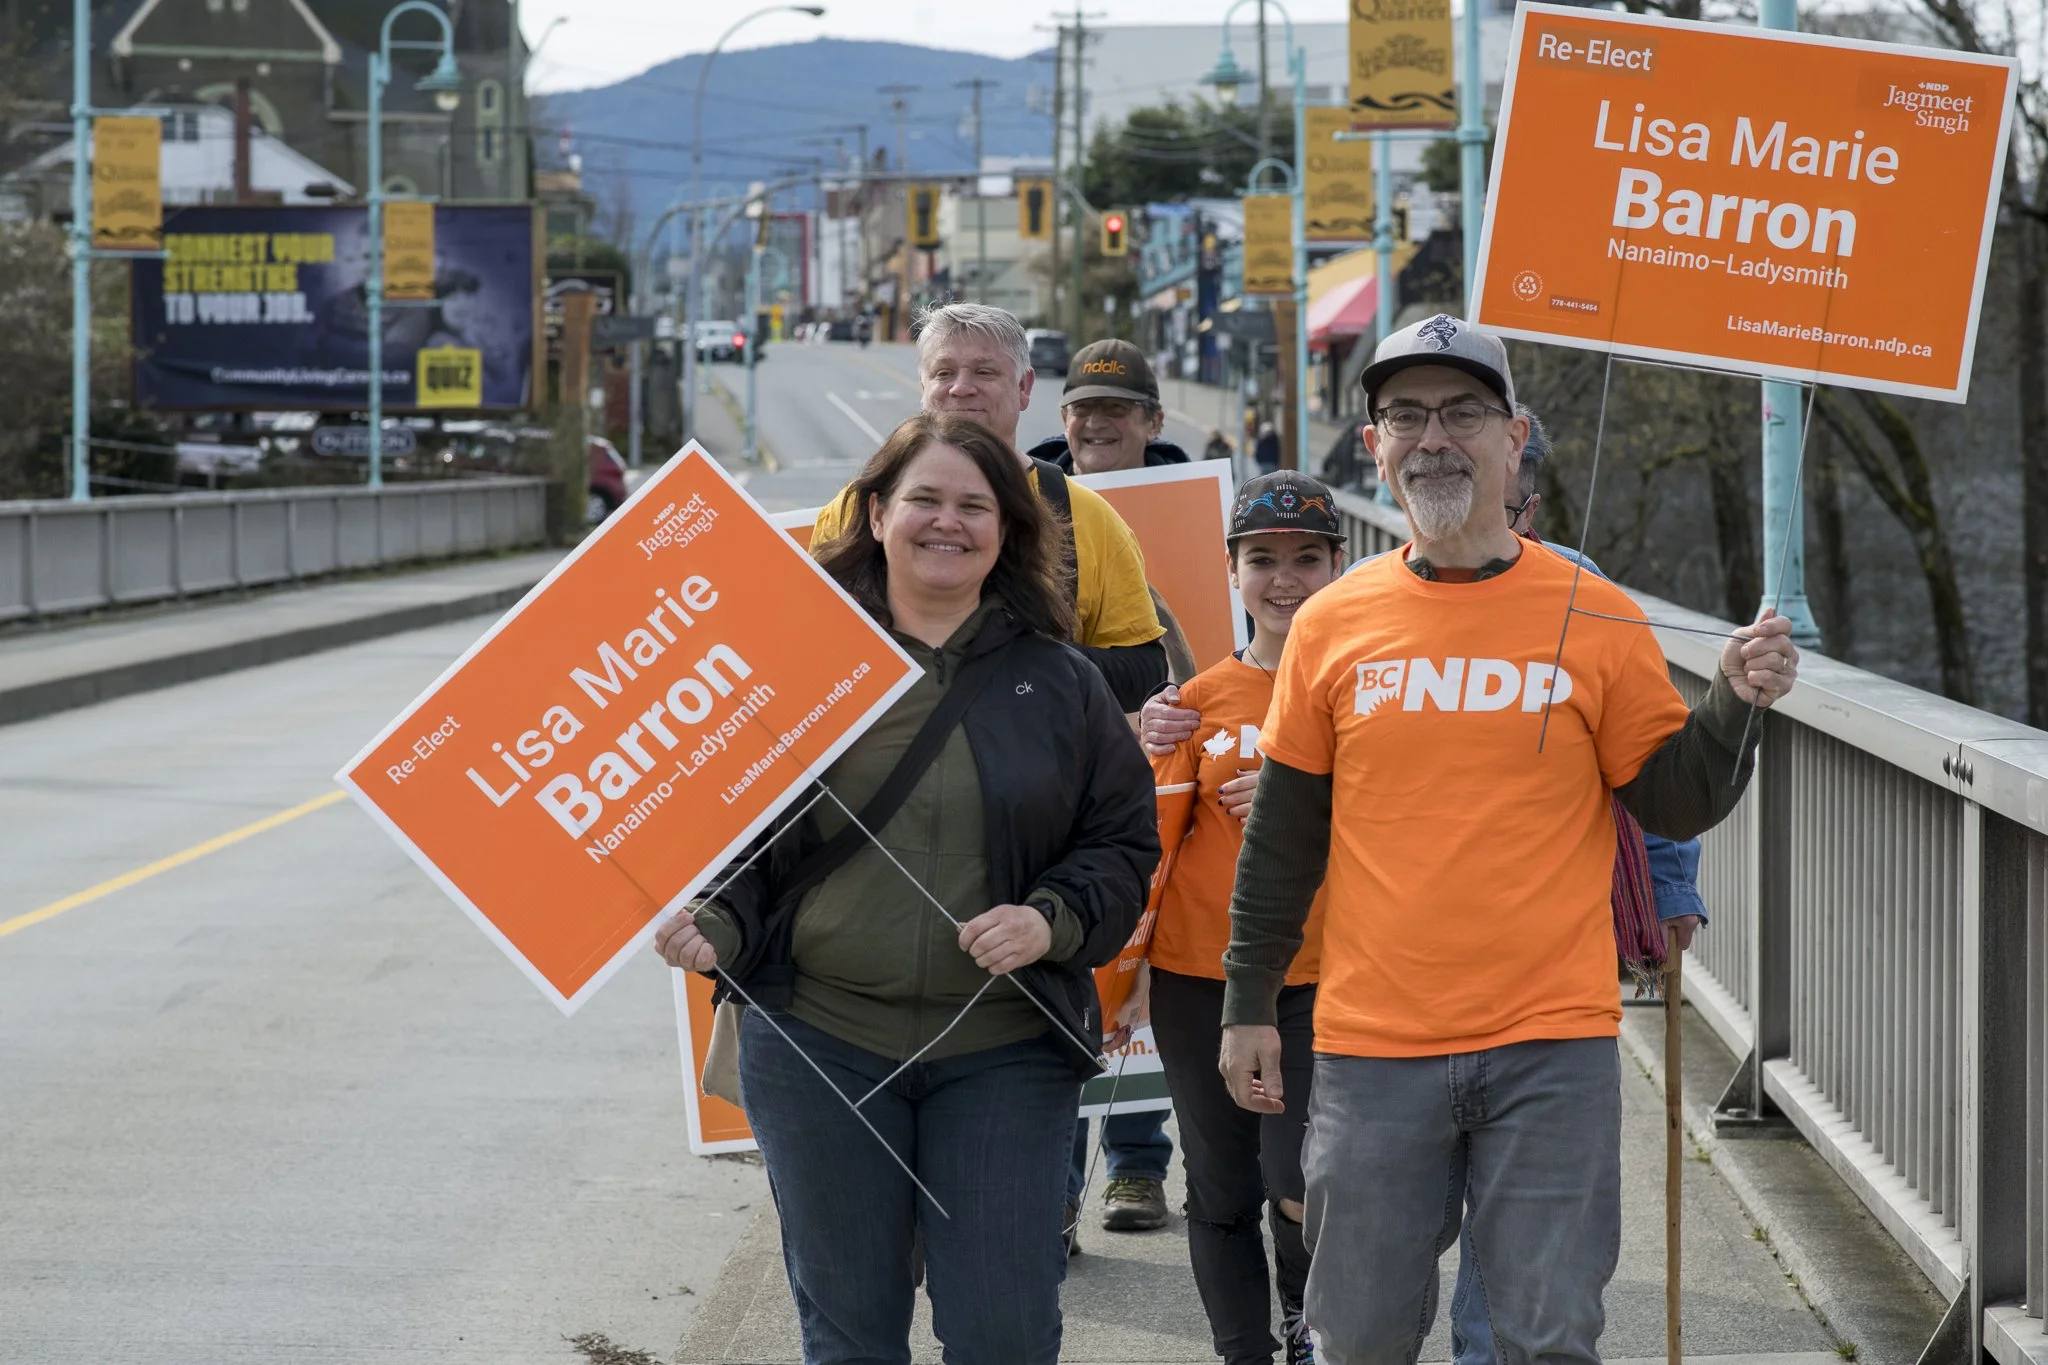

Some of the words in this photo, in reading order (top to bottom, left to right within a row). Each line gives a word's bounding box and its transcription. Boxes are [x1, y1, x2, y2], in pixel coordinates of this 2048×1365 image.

[1538, 33, 1653, 71] Re-Elect
[1883, 85, 1973, 113] Jagmeet
[1926, 82, 1950, 92] NDP
[1593, 100, 1710, 162] Lisa
[1730, 116, 1899, 185] Marie
[1915, 110, 1969, 135] Singh
[1612, 167, 1857, 257] Barron
[1551, 298, 1598, 311] 778-441-5454
[1727, 315, 1932, 357] LisaMarieBarron.ndp.ca
[636, 492, 706, 561] Jagmeet
[674, 508, 719, 548] Singh
[465, 705, 585, 808] Lisa
[569, 574, 719, 709] Marie
[1361, 666, 1398, 690] BC
[1402, 656, 1573, 713] NDP
[386, 715, 462, 785] Re-Elect
[534, 643, 753, 840] Barron
[721, 660, 871, 805] LisaMarieBarron.ndp.ca
